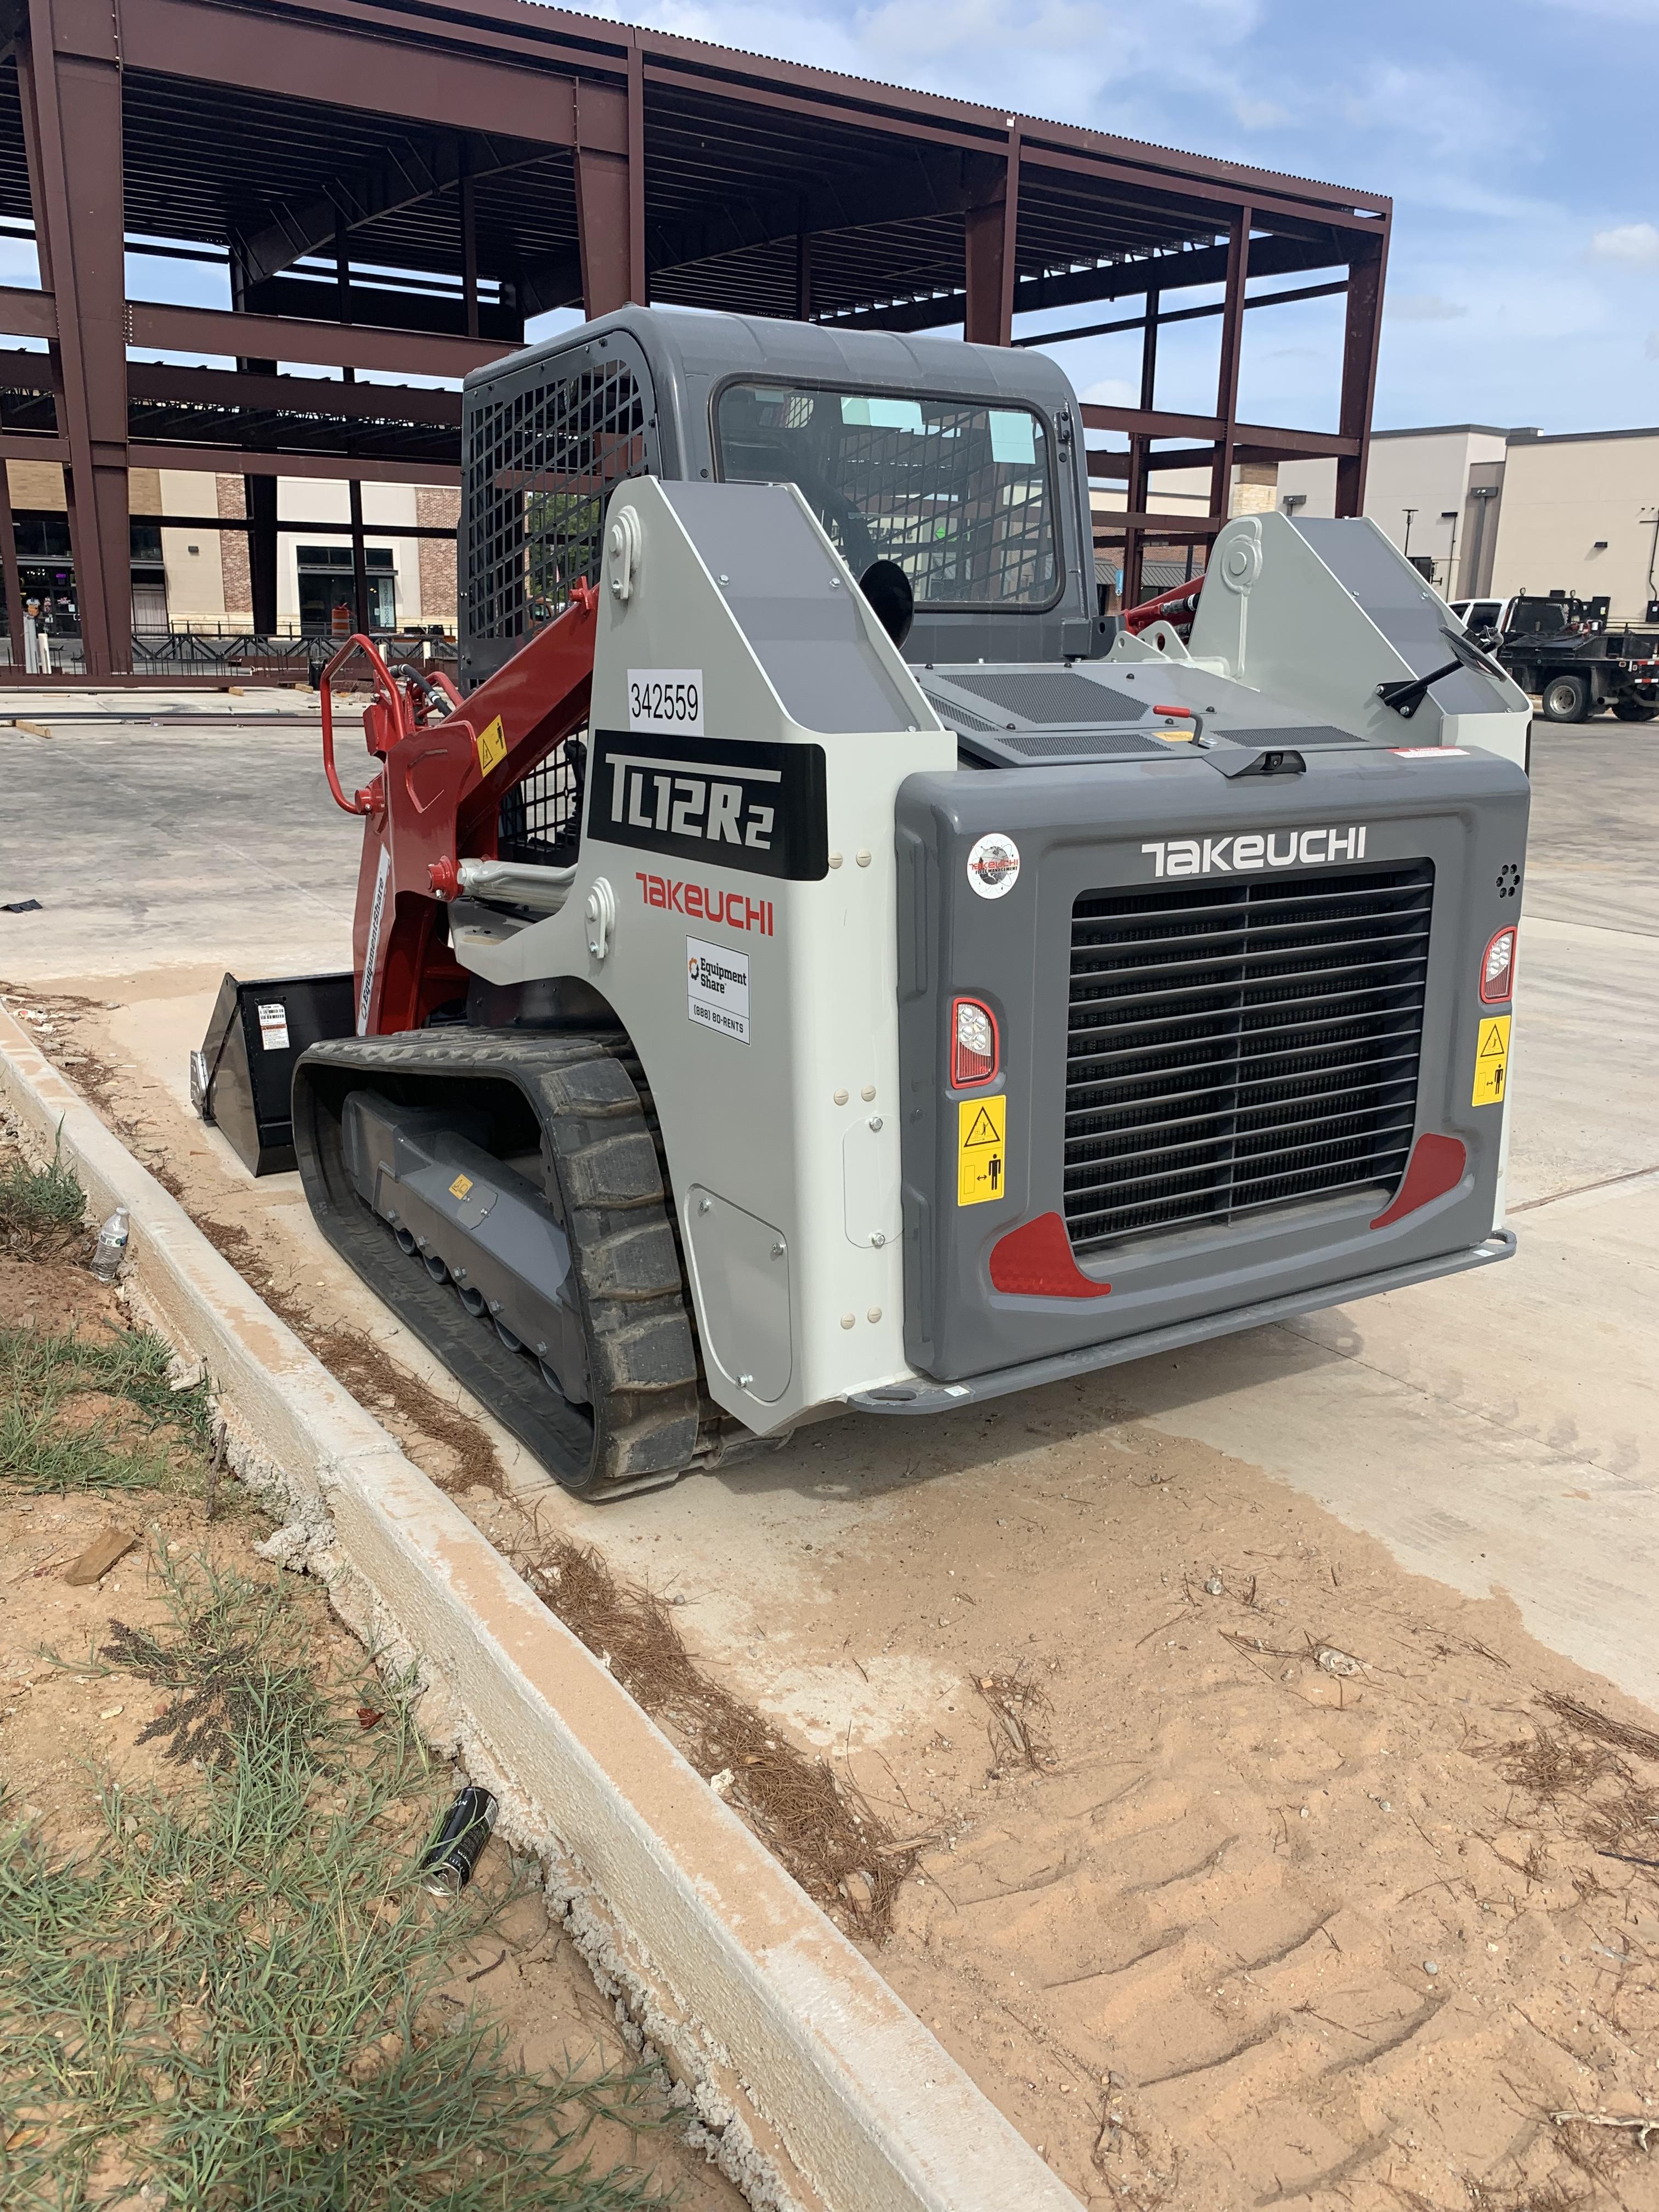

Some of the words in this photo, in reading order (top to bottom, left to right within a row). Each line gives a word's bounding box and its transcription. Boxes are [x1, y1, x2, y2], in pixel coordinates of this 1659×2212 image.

[631, 682, 698, 721] 342559
[605, 753, 782, 850] TL12R2
[362, 877, 385, 1006] EquipmentShare
[700, 957, 747, 986] Equipment
[694, 1005, 710, 1020] (888)
[713, 1013, 743, 1033] 80-RENTS
